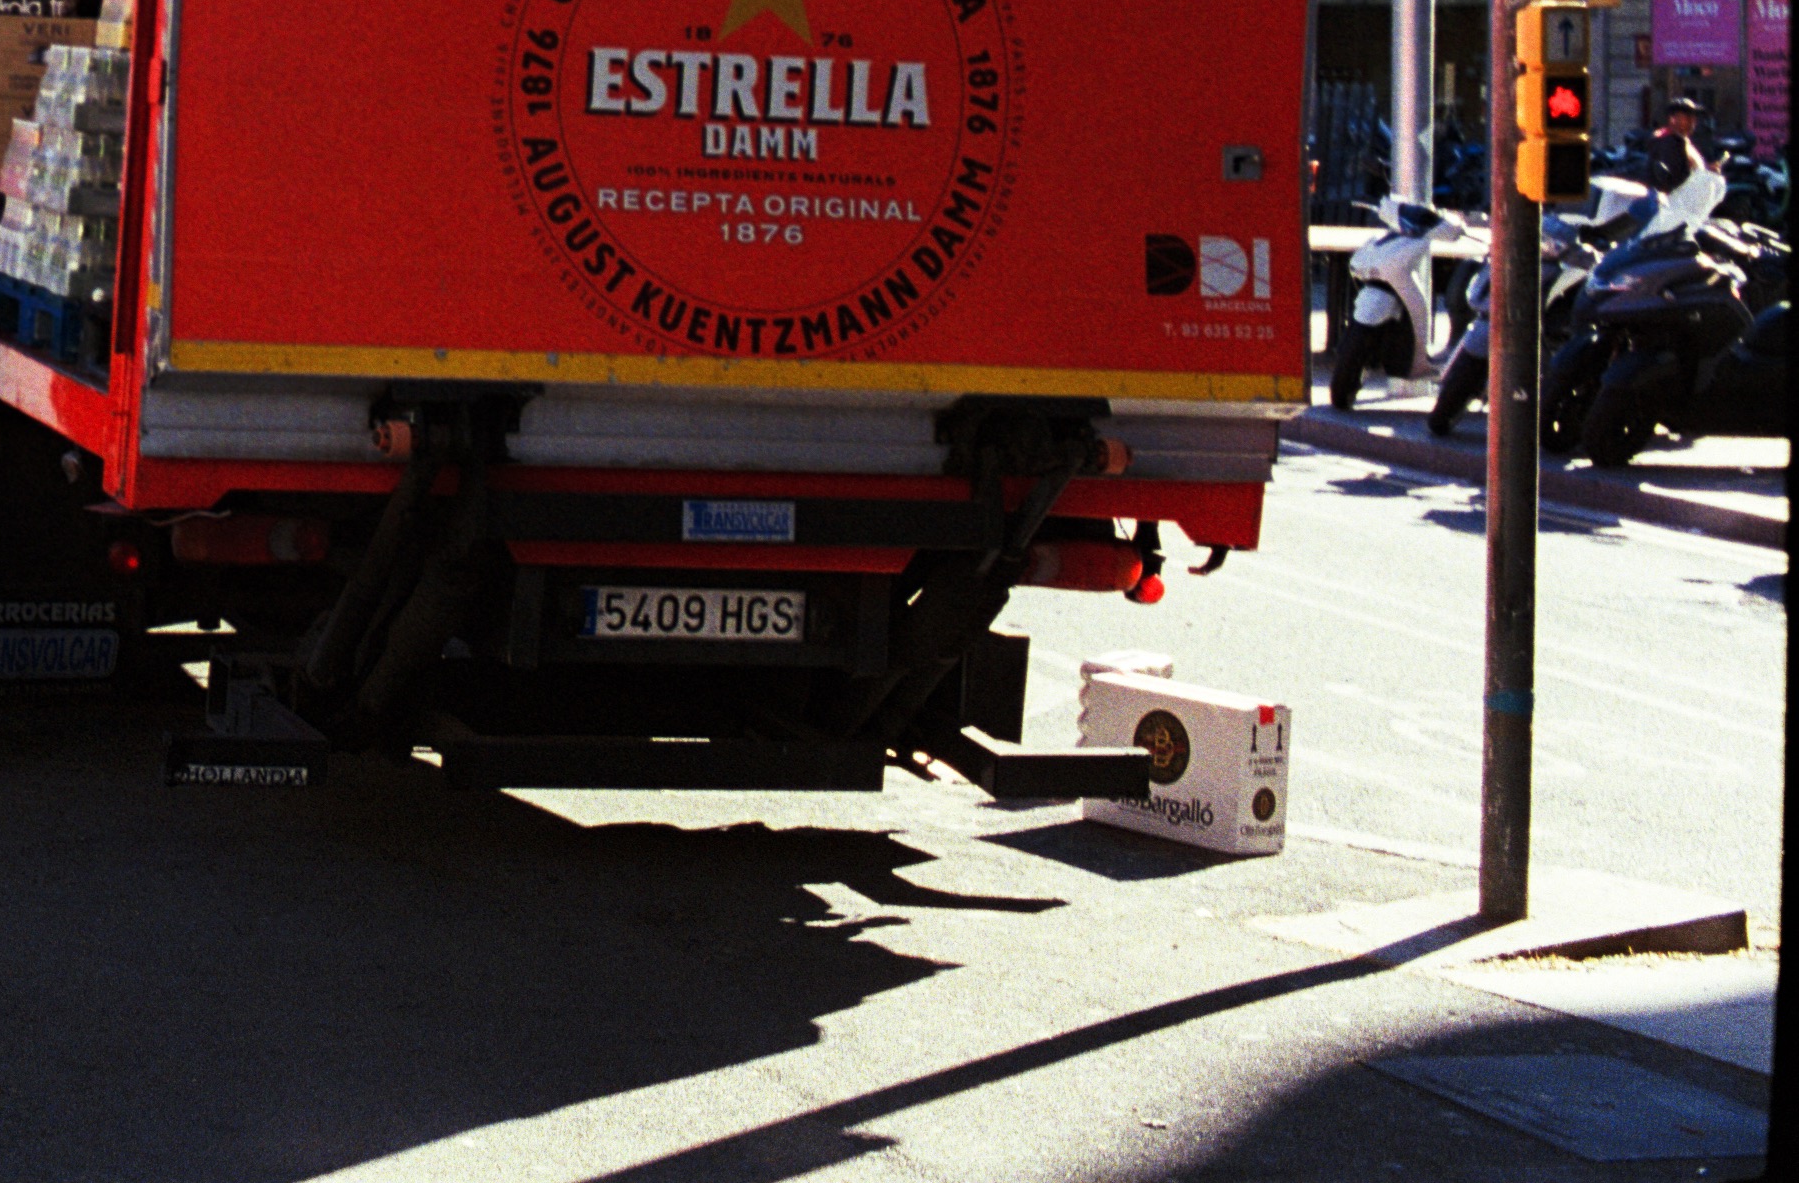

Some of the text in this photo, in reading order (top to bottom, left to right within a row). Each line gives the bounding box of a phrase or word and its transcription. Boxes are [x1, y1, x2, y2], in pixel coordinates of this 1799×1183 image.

[684, 25, 853, 50] 18 76
[521, 28, 560, 116] 1876
[588, 47, 931, 126] ESTRELLA
[967, 50, 998, 136] 1876
[704, 125, 818, 160] DAMM
[677, 167, 798, 182] INGREDIENTS
[802, 172, 896, 187] NATURALS
[597, 188, 922, 222] RECEPTA ORIGINAL
[522, 135, 993, 355] AUGUST KUENTZMANN DAMM
[720, 223, 804, 244] 1876
[1145, 234, 1271, 299] DDI
[1204, 300, 1272, 313] BARCELONA
[1162, 322, 1177, 337] T.
[605, 593, 794, 635] 5409 HGS
